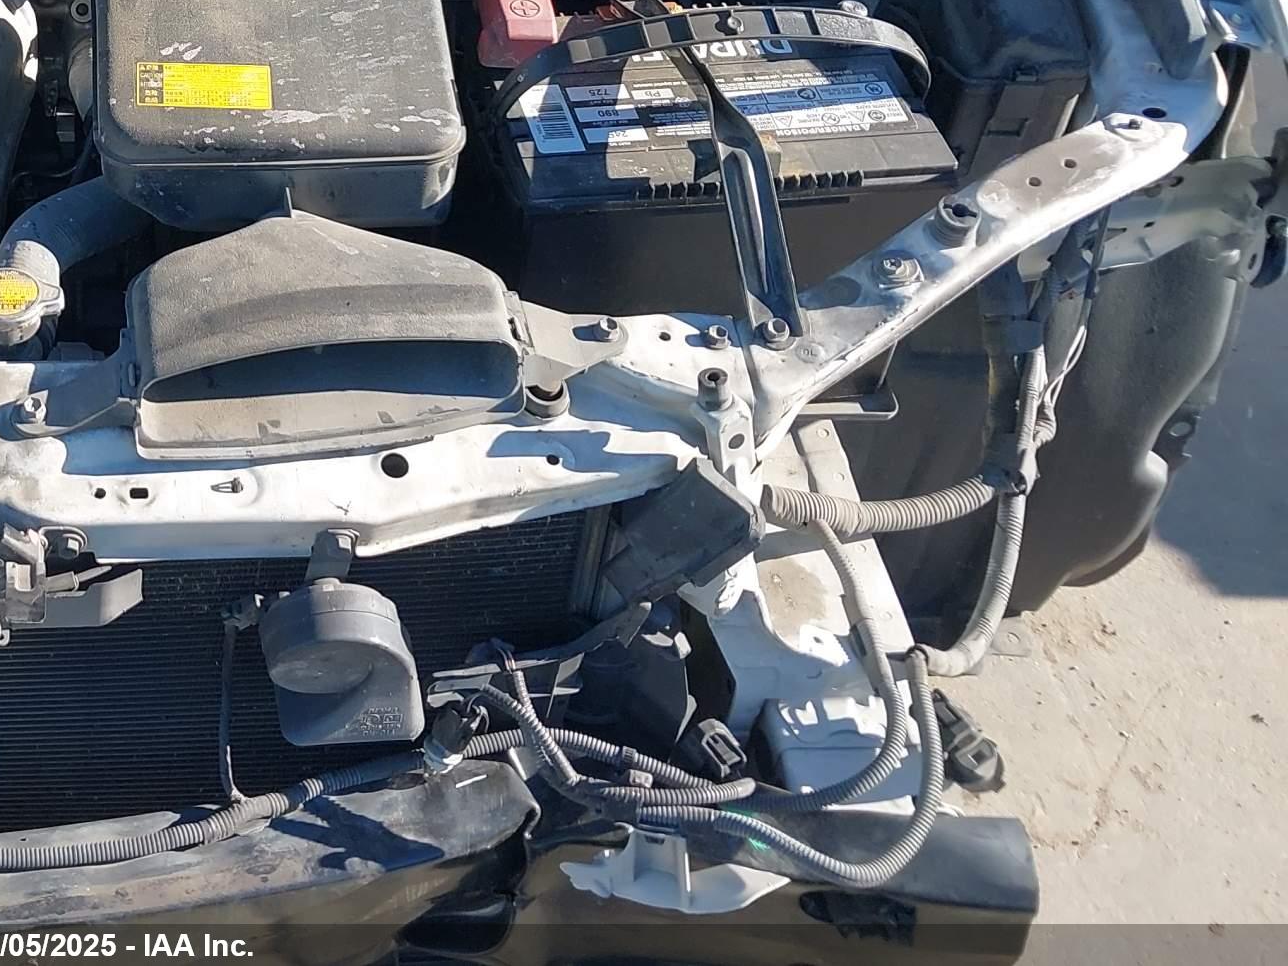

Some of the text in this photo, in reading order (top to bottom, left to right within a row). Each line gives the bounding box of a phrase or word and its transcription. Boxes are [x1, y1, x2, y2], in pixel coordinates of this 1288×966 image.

[588, 88, 610, 97] 725
[644, 90, 662, 98] Pb
[597, 109, 619, 118] 890
